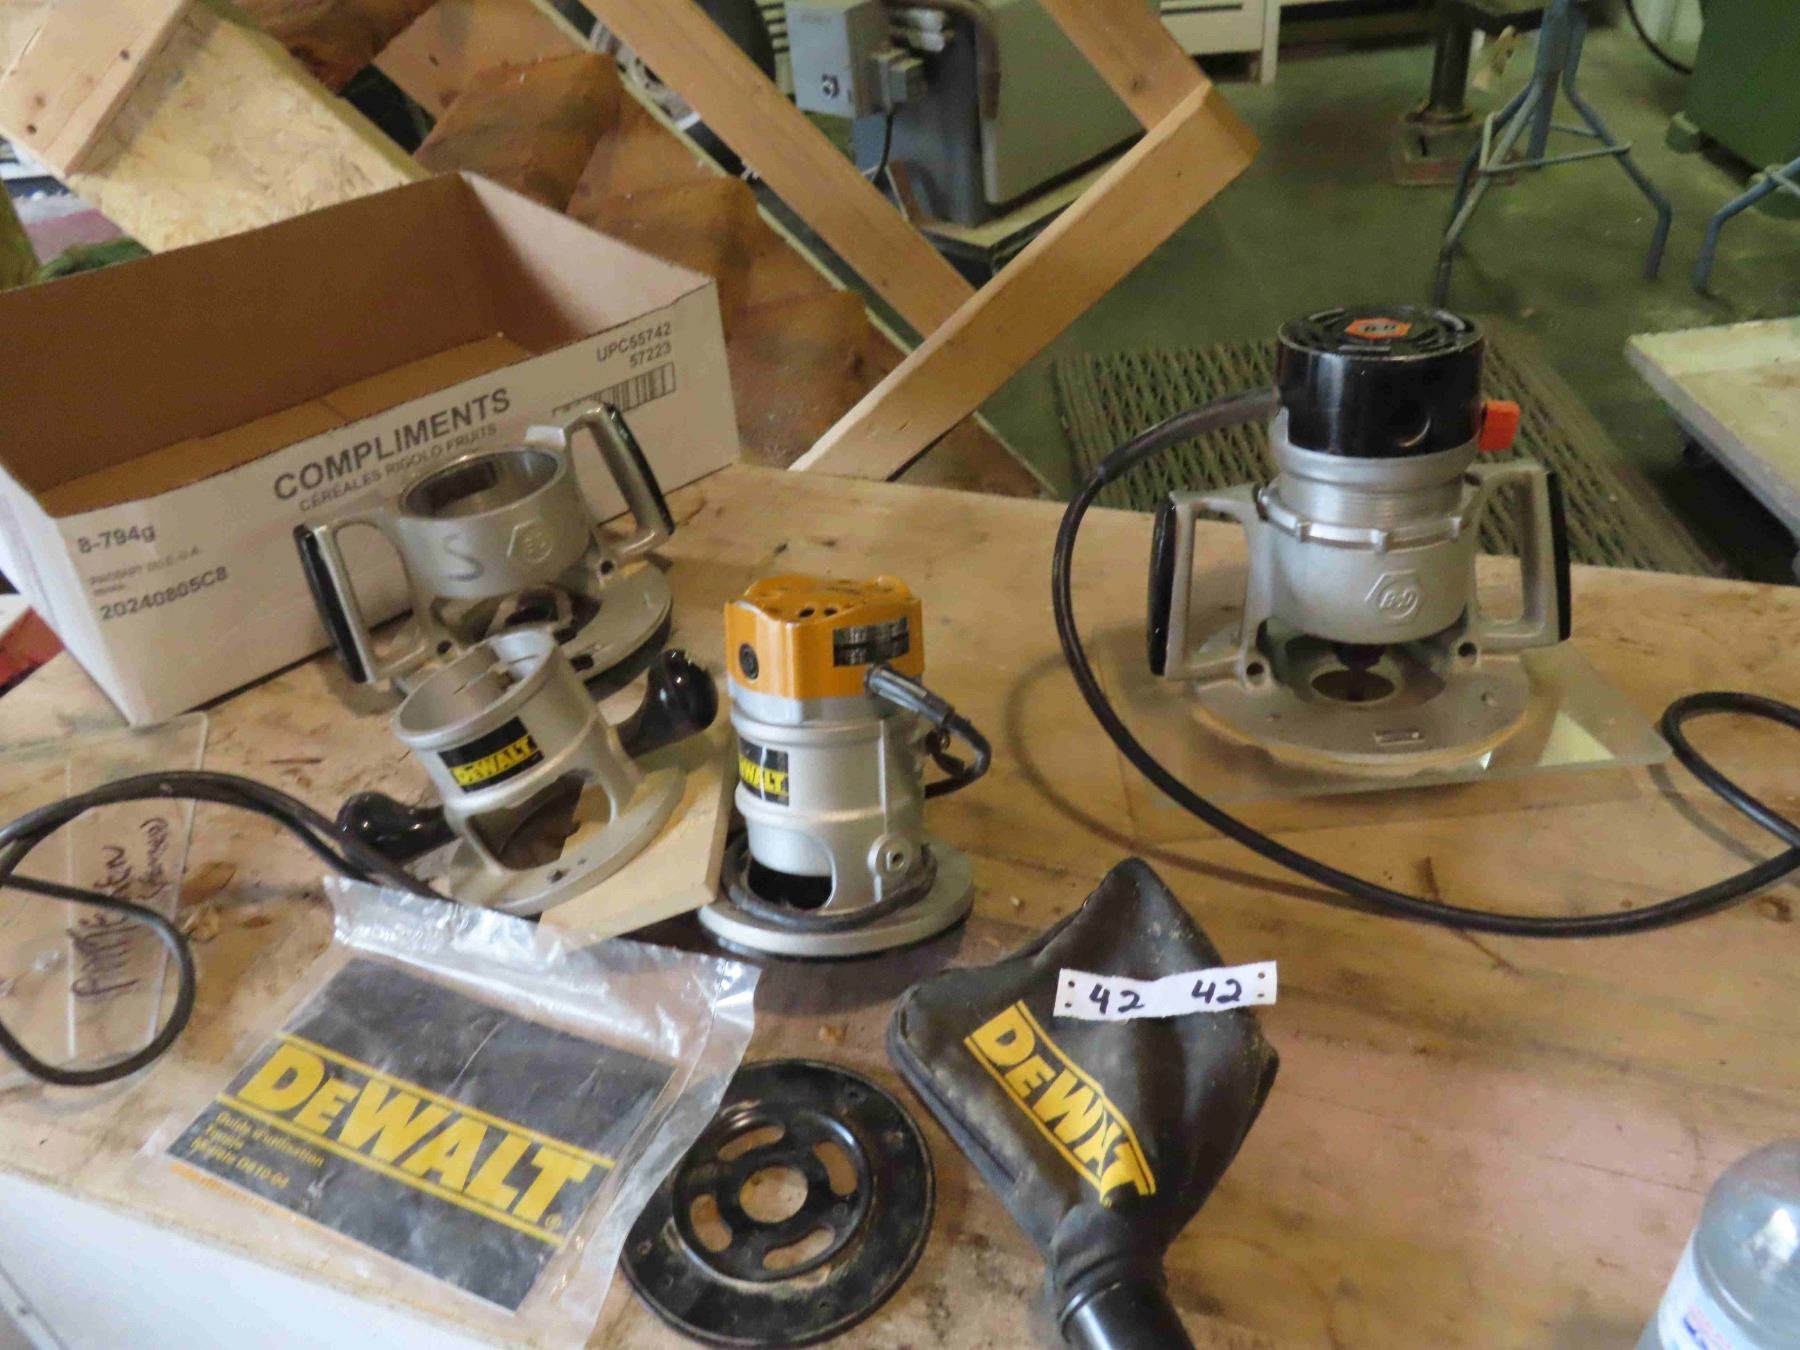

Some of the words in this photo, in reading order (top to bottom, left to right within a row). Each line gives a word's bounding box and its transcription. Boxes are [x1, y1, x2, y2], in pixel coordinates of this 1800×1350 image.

[596, 321, 671, 362] UPC55742
[630, 341, 671, 368] 57223
[273, 388, 511, 500] COMPLIMENTS
[445, 423, 497, 452] FRUITS
[77, 525, 156, 554] 8-794g
[100, 565, 229, 621] 20240805C8
[451, 737, 533, 785] DEWALT
[739, 757, 785, 795] WALT
[1089, 984, 1145, 1014] 42
[1191, 979, 1243, 1003] 42
[237, 1042, 592, 1223] DEWALT
